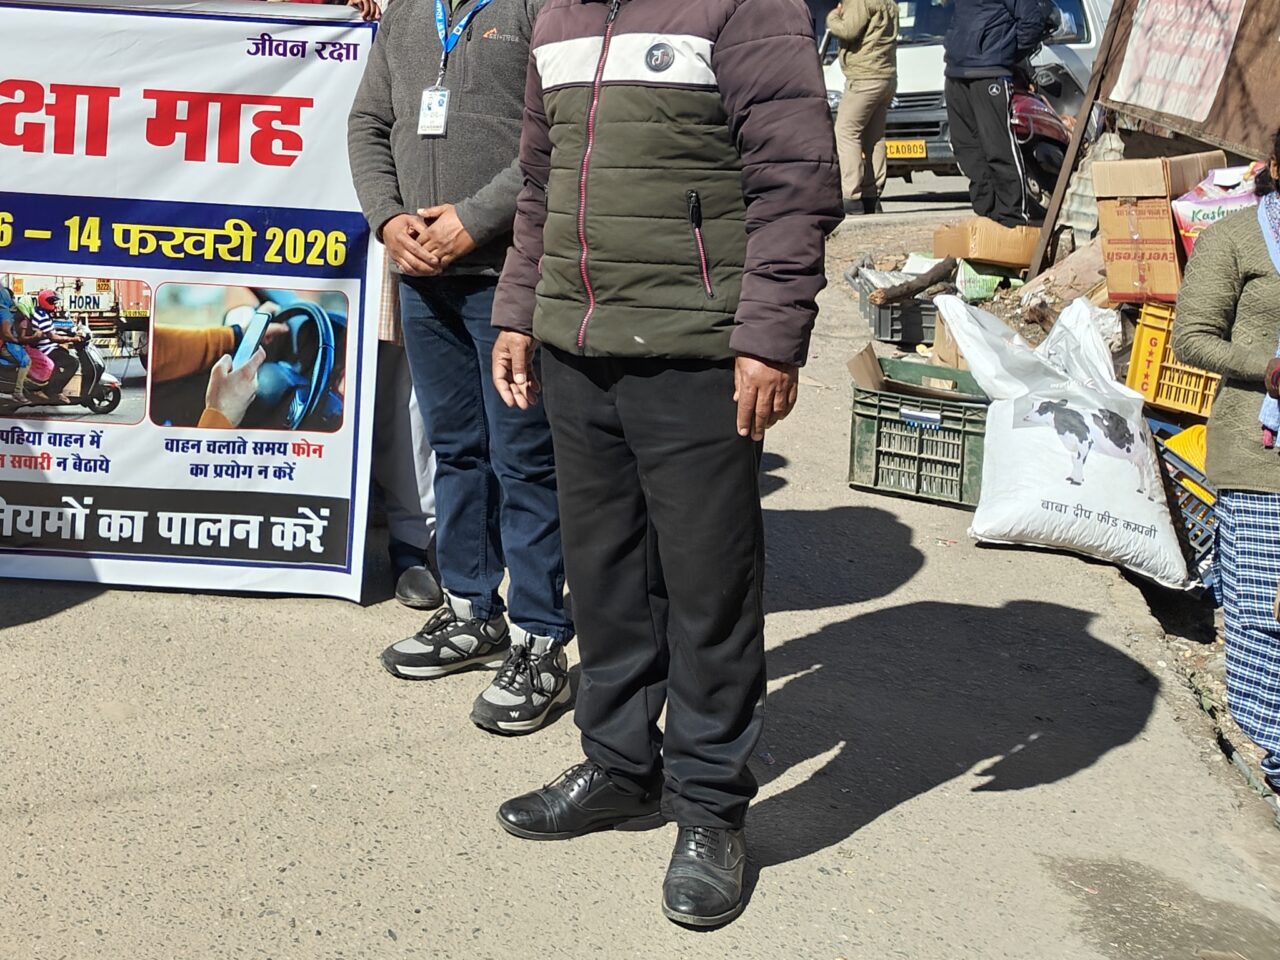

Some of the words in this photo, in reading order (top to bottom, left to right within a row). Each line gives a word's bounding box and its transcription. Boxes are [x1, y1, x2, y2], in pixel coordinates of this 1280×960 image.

[246, 33, 308, 58] जीवन
[315, 41, 360, 62] रक्षा
[143, 88, 314, 167] माह
[64, 215, 101, 252] 14
[112, 218, 257, 262] फरवरी
[264, 227, 347, 266] 2026
[69, 295, 100, 309] HORN
[47, 432, 85, 448] वाहन
[89, 430, 103, 449] में
[164, 438, 202, 453] वाहन
[206, 436, 248, 455] चलाते
[252, 441, 288, 456] समय
[292, 438, 324, 458] फोन
[10, 452, 52, 470] सवारी
[56, 456, 68, 471] न
[70, 453, 111, 473] बैठाये
[190, 463, 209, 477] का
[213, 460, 254, 478] प्रयोग
[257, 465, 270, 479] न
[273, 462, 296, 481] करें
[97, 509, 148, 542] का
[157, 511, 263, 548] पालन
[270, 508, 330, 553] करें
[1041, 499, 1069, 514] बाबा
[1073, 503, 1093, 520] दीप
[1096, 510, 1120, 528] फीड
[1122, 519, 1159, 539] कम्पनी
